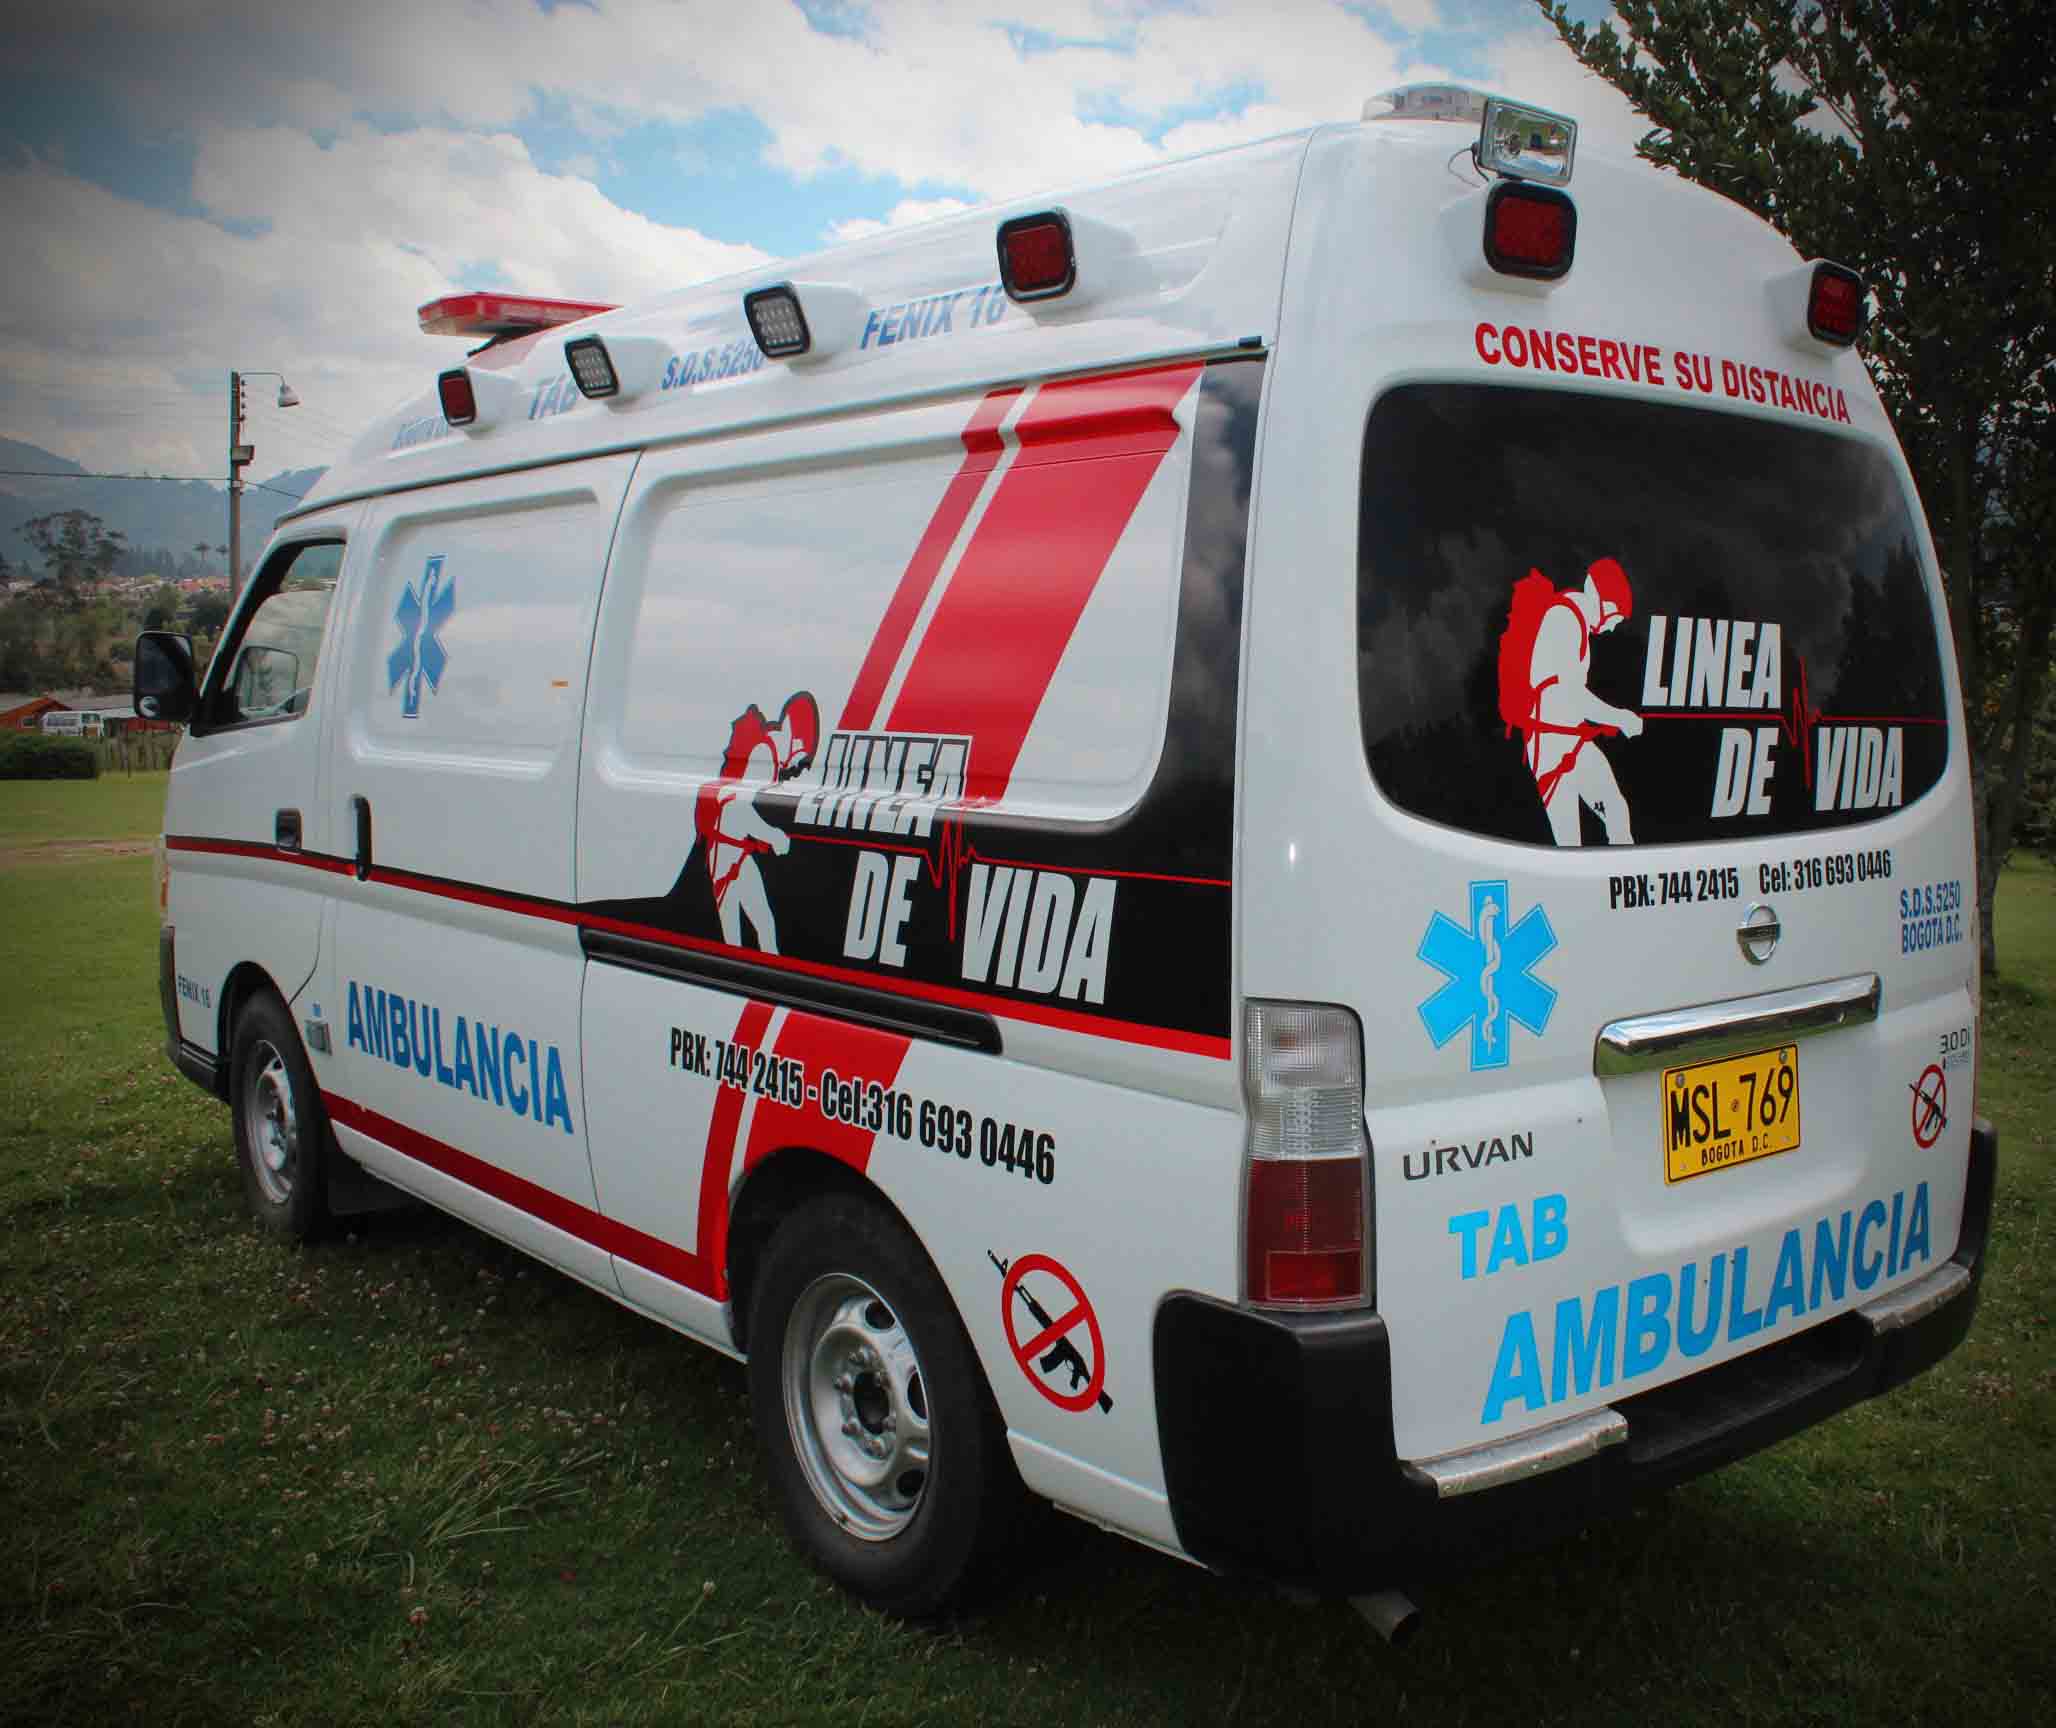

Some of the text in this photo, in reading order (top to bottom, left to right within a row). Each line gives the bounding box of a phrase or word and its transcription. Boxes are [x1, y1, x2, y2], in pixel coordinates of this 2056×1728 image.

[860, 291, 965, 350] FENIX
[1475, 322, 1851, 425] CONSERVE SU DISTANCIA
[1642, 614, 1782, 710] LINEA
[794, 734, 971, 839] LINEA
[1711, 726, 1904, 818] DE VIDA
[1608, 849, 1892, 910] PBX: 744 2415 Cel: 316 693 0446
[1899, 879, 1961, 919] S.D.S.5250
[843, 850, 1117, 1005] DE VIDA
[1902, 917, 1944, 954] BOGOTA
[346, 980, 574, 1135] AMBULANCIA
[670, 1027, 711, 1077] PBX:
[714, 1039, 749, 1090] 744
[752, 1051, 804, 1107] 2415
[919, 1099, 973, 1160] 693
[980, 1116, 1056, 1185] 0446
[1670, 1065, 1794, 1152] MSL 769
[1402, 1130, 1534, 1182] URVAN
[1701, 1138, 1745, 1167] BOGOTA
[1448, 1192, 1570, 1281] TAB
[1480, 1180, 1931, 1425] AMBULANCIA
